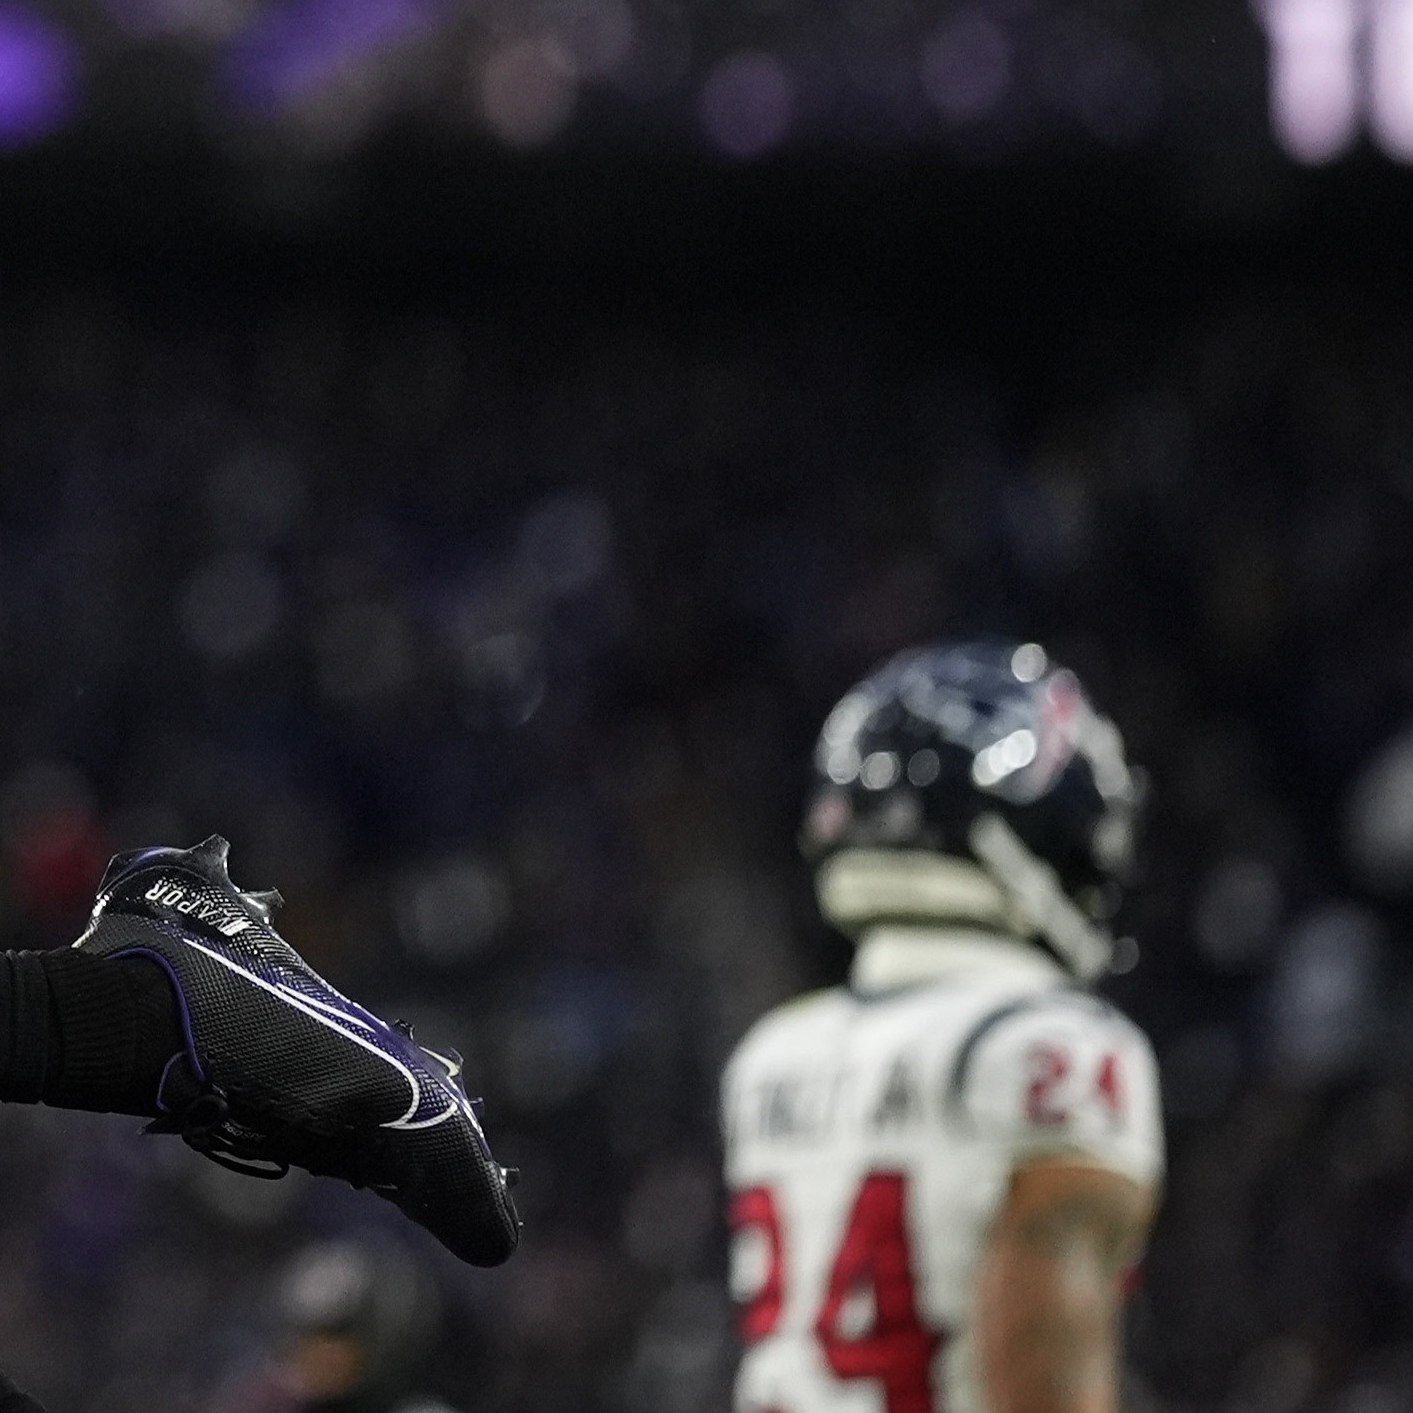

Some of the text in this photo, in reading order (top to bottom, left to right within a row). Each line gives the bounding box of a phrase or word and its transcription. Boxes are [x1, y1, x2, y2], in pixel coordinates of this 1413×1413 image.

[145, 880, 231, 931] VAPOR
[1026, 1041, 1126, 1130] 24
[726, 1166, 948, 1413] 24
